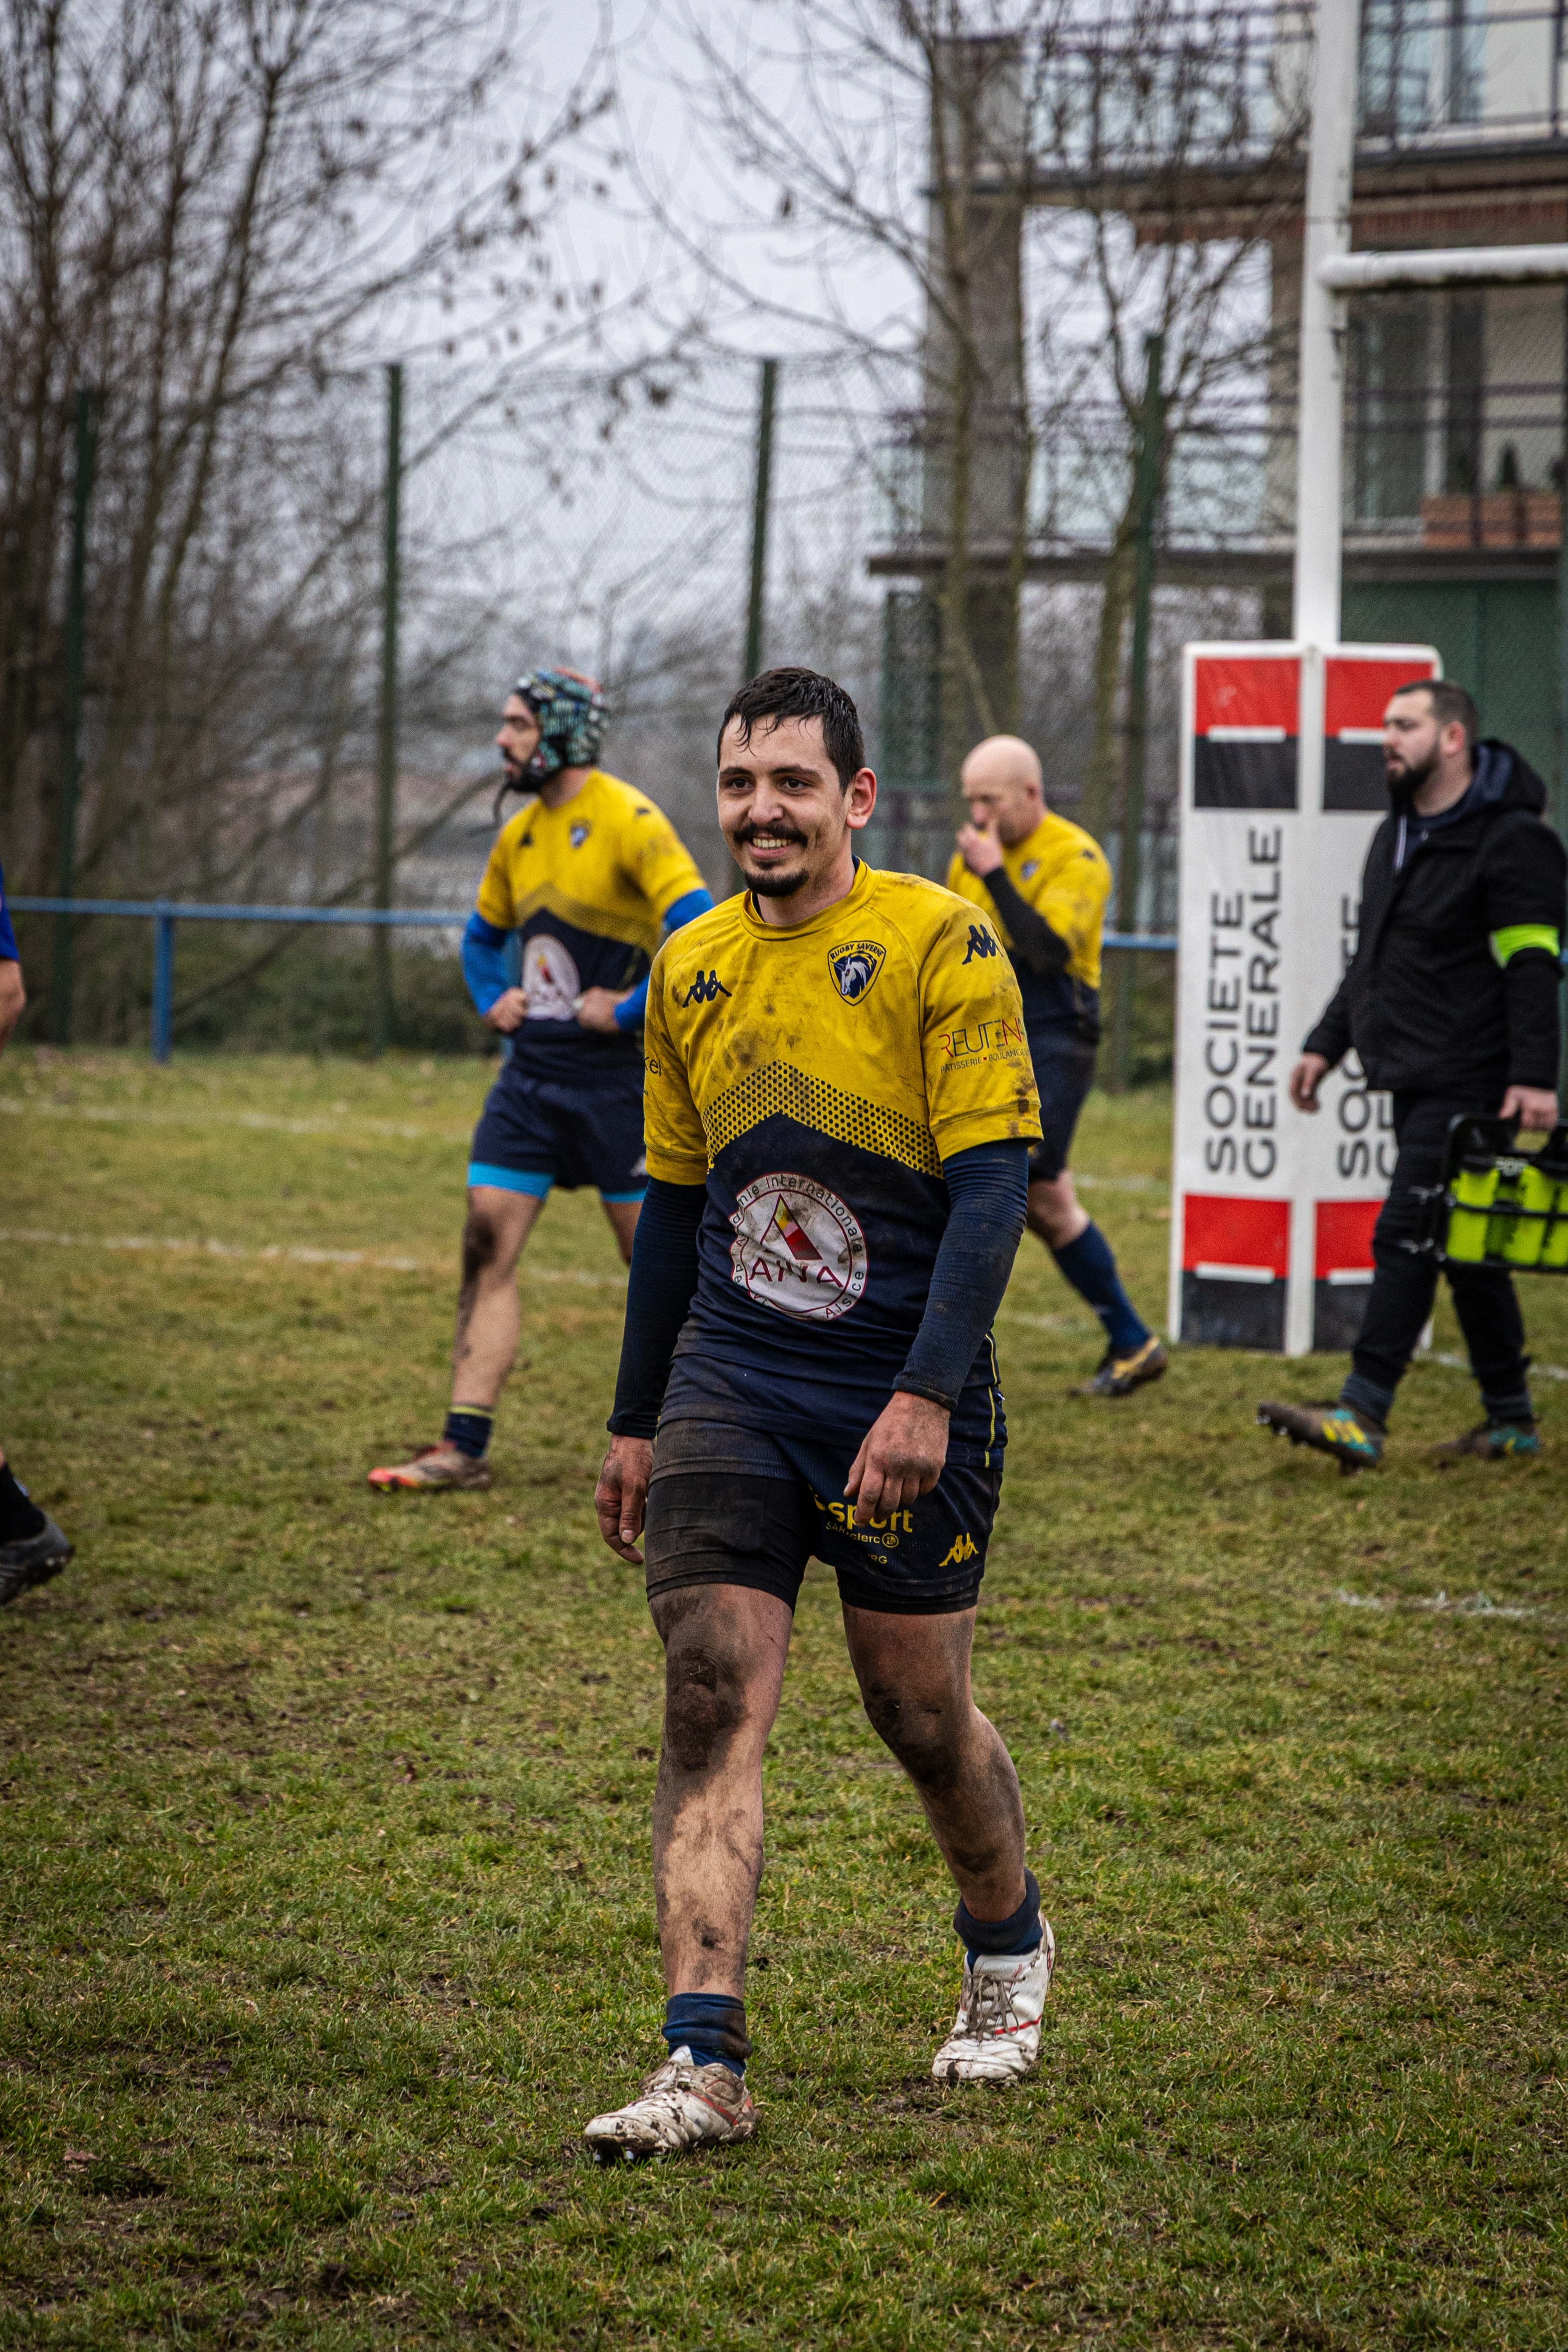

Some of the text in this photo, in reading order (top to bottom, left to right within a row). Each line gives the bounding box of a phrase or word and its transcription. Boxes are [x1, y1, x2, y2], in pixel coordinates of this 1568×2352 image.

[830, 943, 884, 960] RUGBY SAVERNE
[1205, 891, 1242, 1175] SOCIETE
[1244, 828, 1282, 1178] GENERALE
[766, 1174, 863, 1252] Internationale
